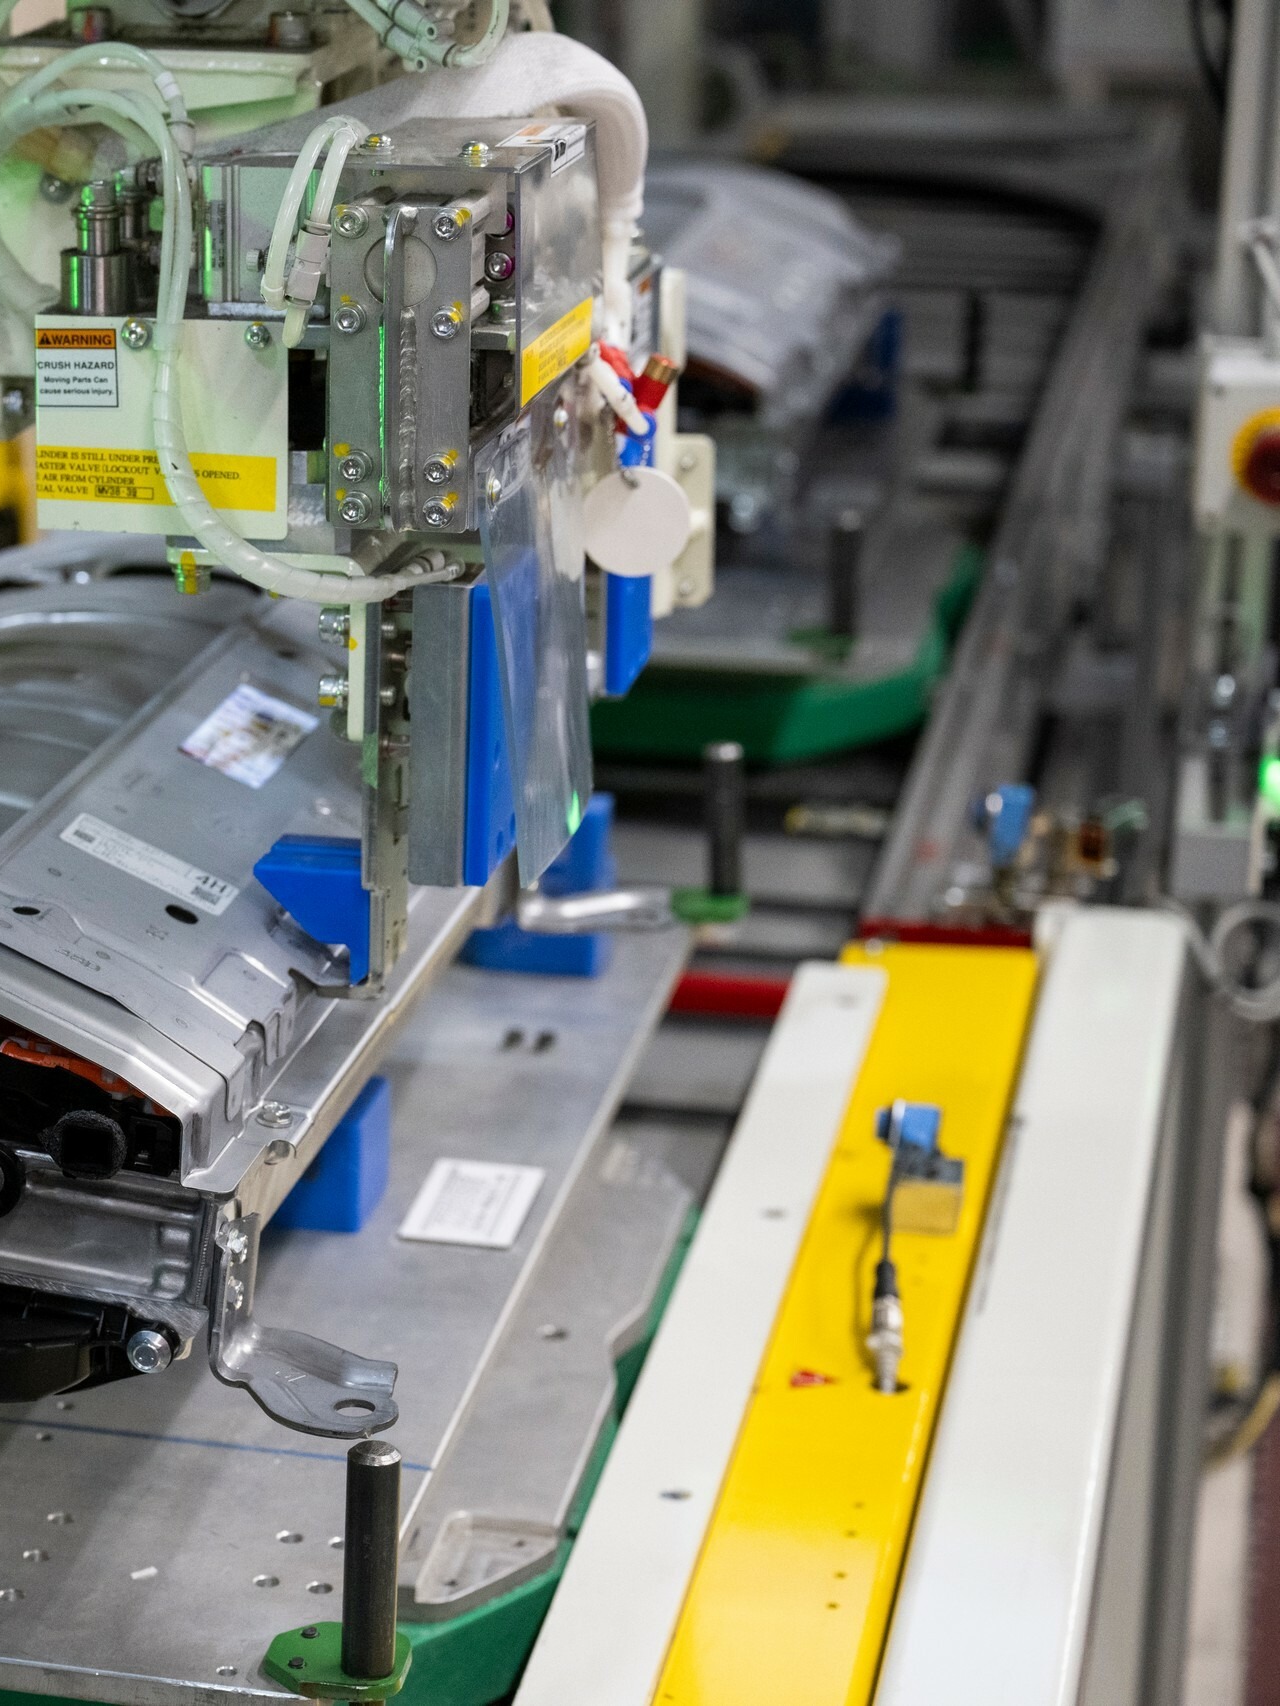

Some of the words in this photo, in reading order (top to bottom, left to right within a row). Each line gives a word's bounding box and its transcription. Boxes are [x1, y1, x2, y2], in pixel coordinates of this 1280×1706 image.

[51, 334, 112, 346] WARNING
[37, 361, 71, 370] CRUSH
[73, 361, 115, 370] HAZARD
[43, 376, 70, 385] Moving
[63, 387, 90, 395] serious
[91, 387, 114, 396] injury.
[70, 450, 79, 460] IS
[80, 451, 107, 461] STILL
[108, 453, 141, 463] UNDER
[69, 463, 101, 472] VALVE
[102, 464, 150, 475] (LOCKOUT
[42, 473, 58, 481] AIR
[60, 473, 87, 483] FROM
[87, 475, 135, 485] CYLINDER
[57, 485, 89, 494] VALVE
